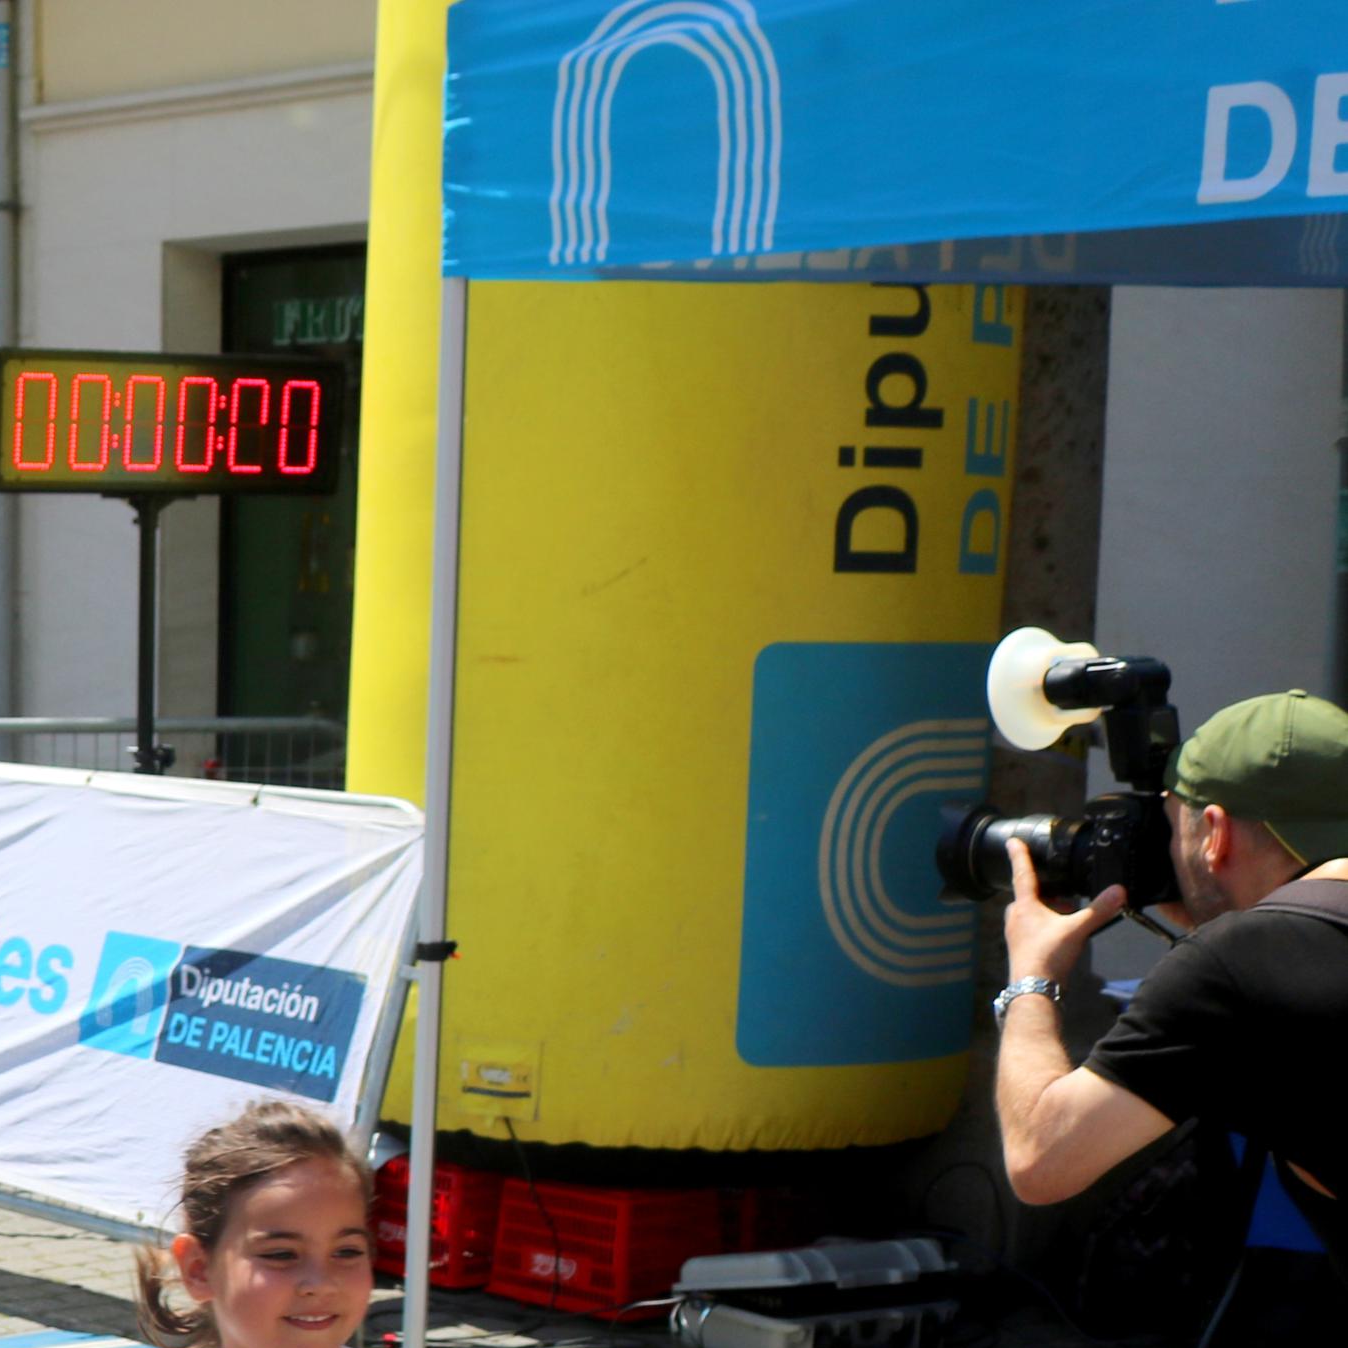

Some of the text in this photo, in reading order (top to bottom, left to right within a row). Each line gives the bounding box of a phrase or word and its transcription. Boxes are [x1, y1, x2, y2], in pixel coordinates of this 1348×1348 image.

[959, 397, 1009, 575] DE
[180, 963, 319, 1024] Diputación
[167, 1011, 336, 1081] DE PALENCIA
